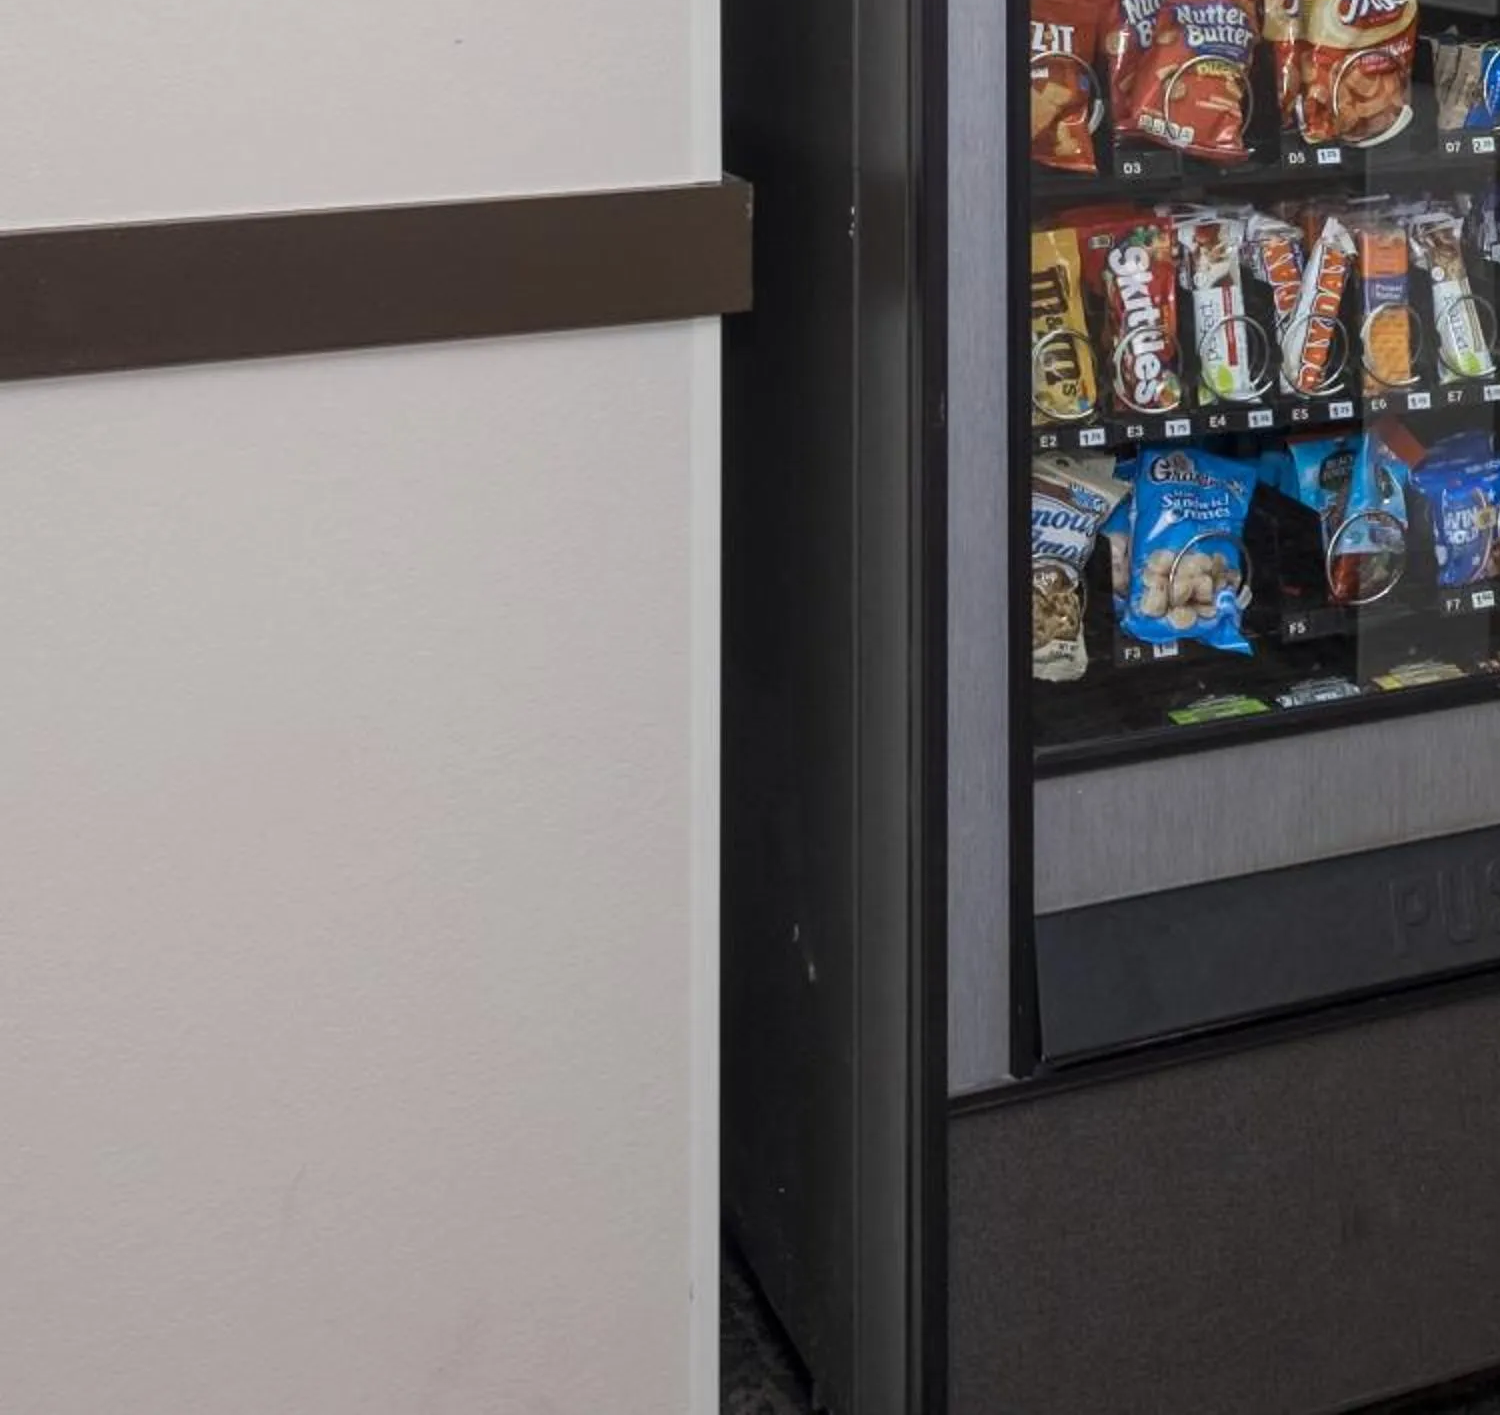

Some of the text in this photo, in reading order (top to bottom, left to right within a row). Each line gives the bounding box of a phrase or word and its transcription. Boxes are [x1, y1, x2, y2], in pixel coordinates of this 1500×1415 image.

[1175, 3, 1248, 25] Nutter
[1187, 24, 1253, 47] Butter
[1108, 245, 1166, 404] Skittles
[1447, 390, 1463, 402] E7
[1292, 409, 1309, 421] E5
[1209, 416, 1226, 429] E4
[1127, 427, 1144, 438] E3
[1040, 436, 1057, 448] E2
